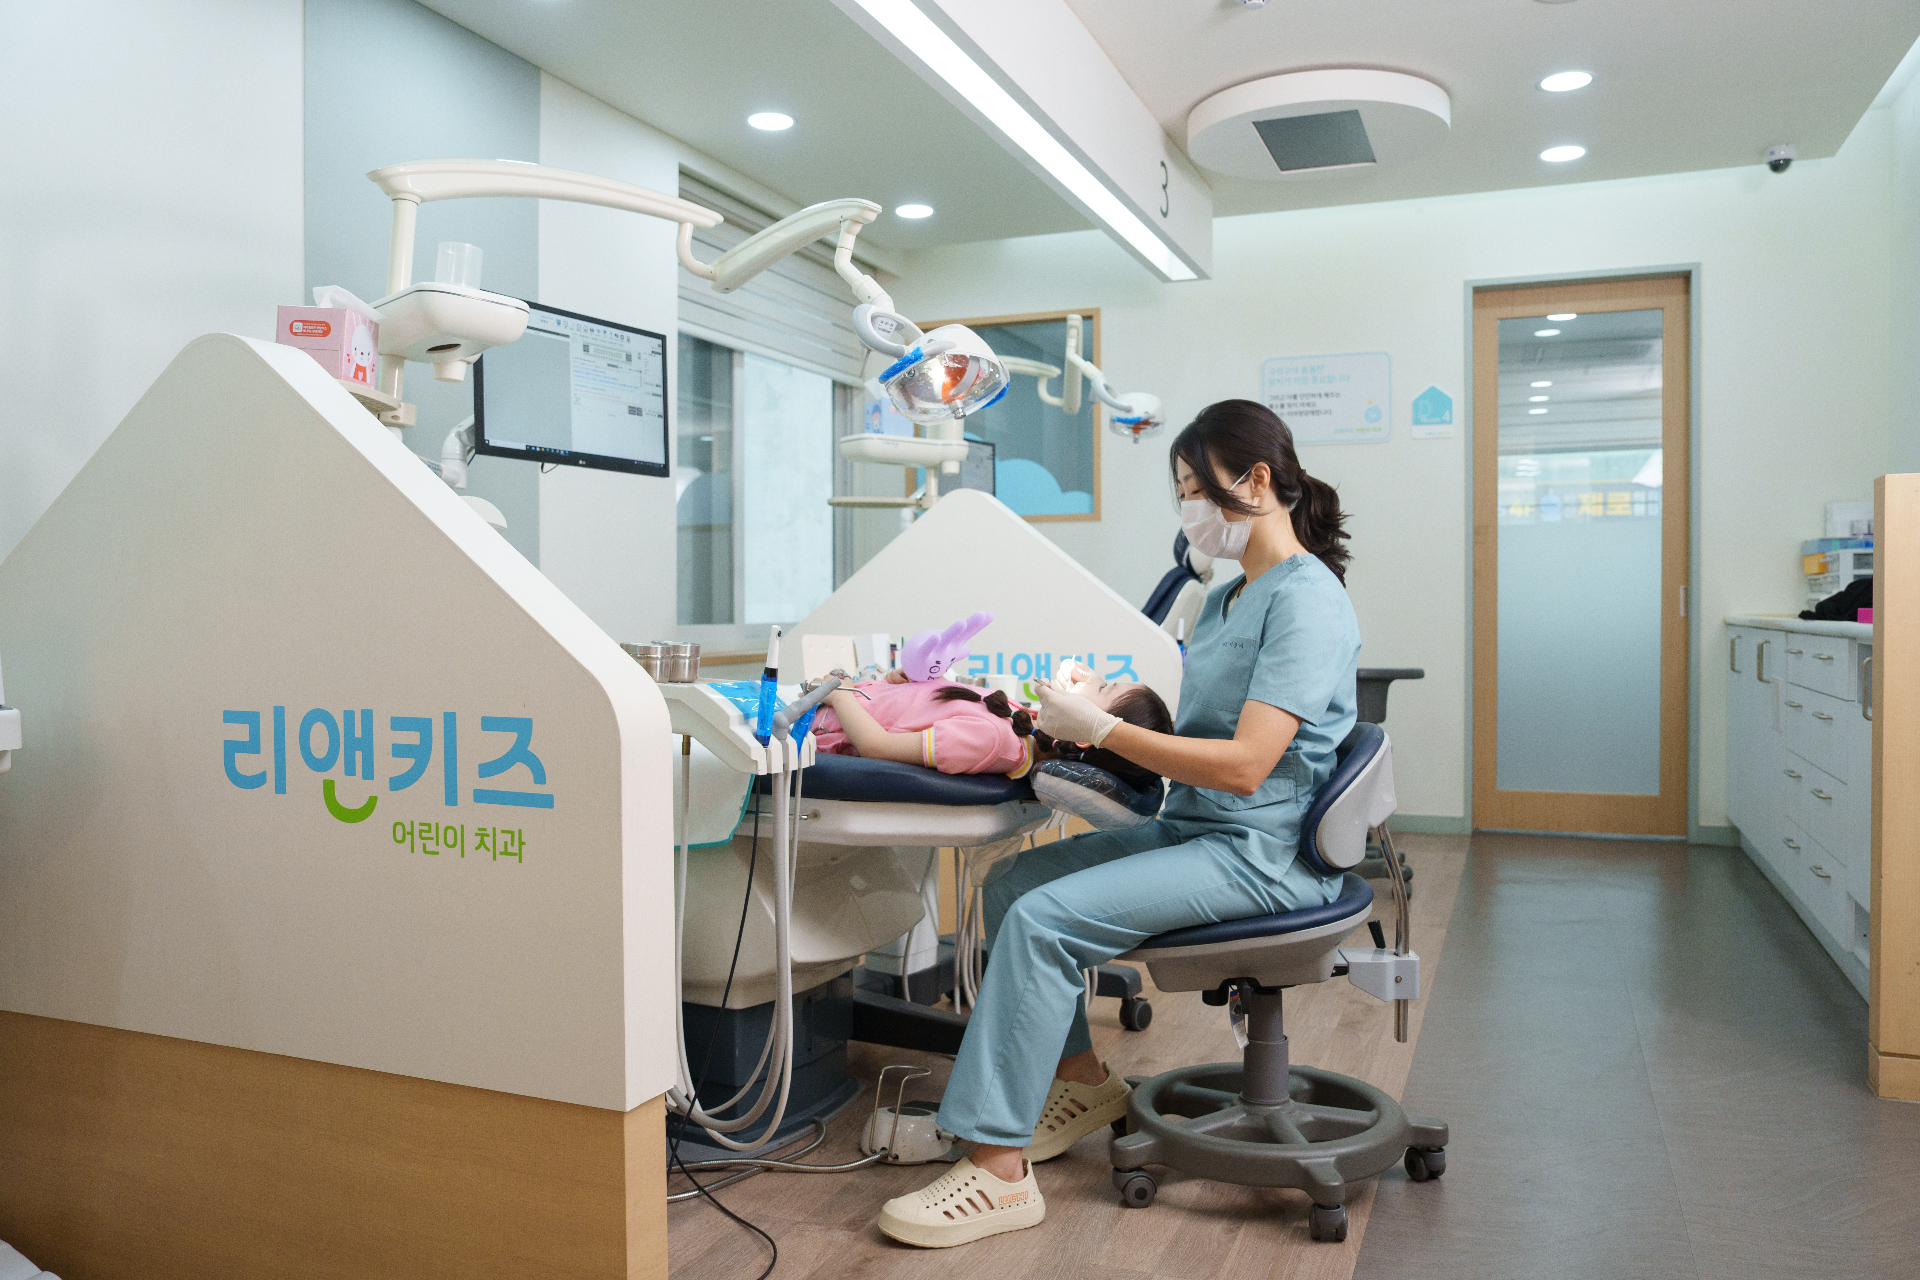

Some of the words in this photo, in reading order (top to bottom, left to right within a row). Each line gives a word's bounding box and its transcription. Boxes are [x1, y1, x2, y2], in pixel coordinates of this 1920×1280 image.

[1160, 160, 1169, 218] 3
[1441, 409, 1451, 423] 4
[222, 705, 555, 824] 리앤키즈
[392, 820, 465, 858] 어린이
[474, 826, 526, 863] 치과
